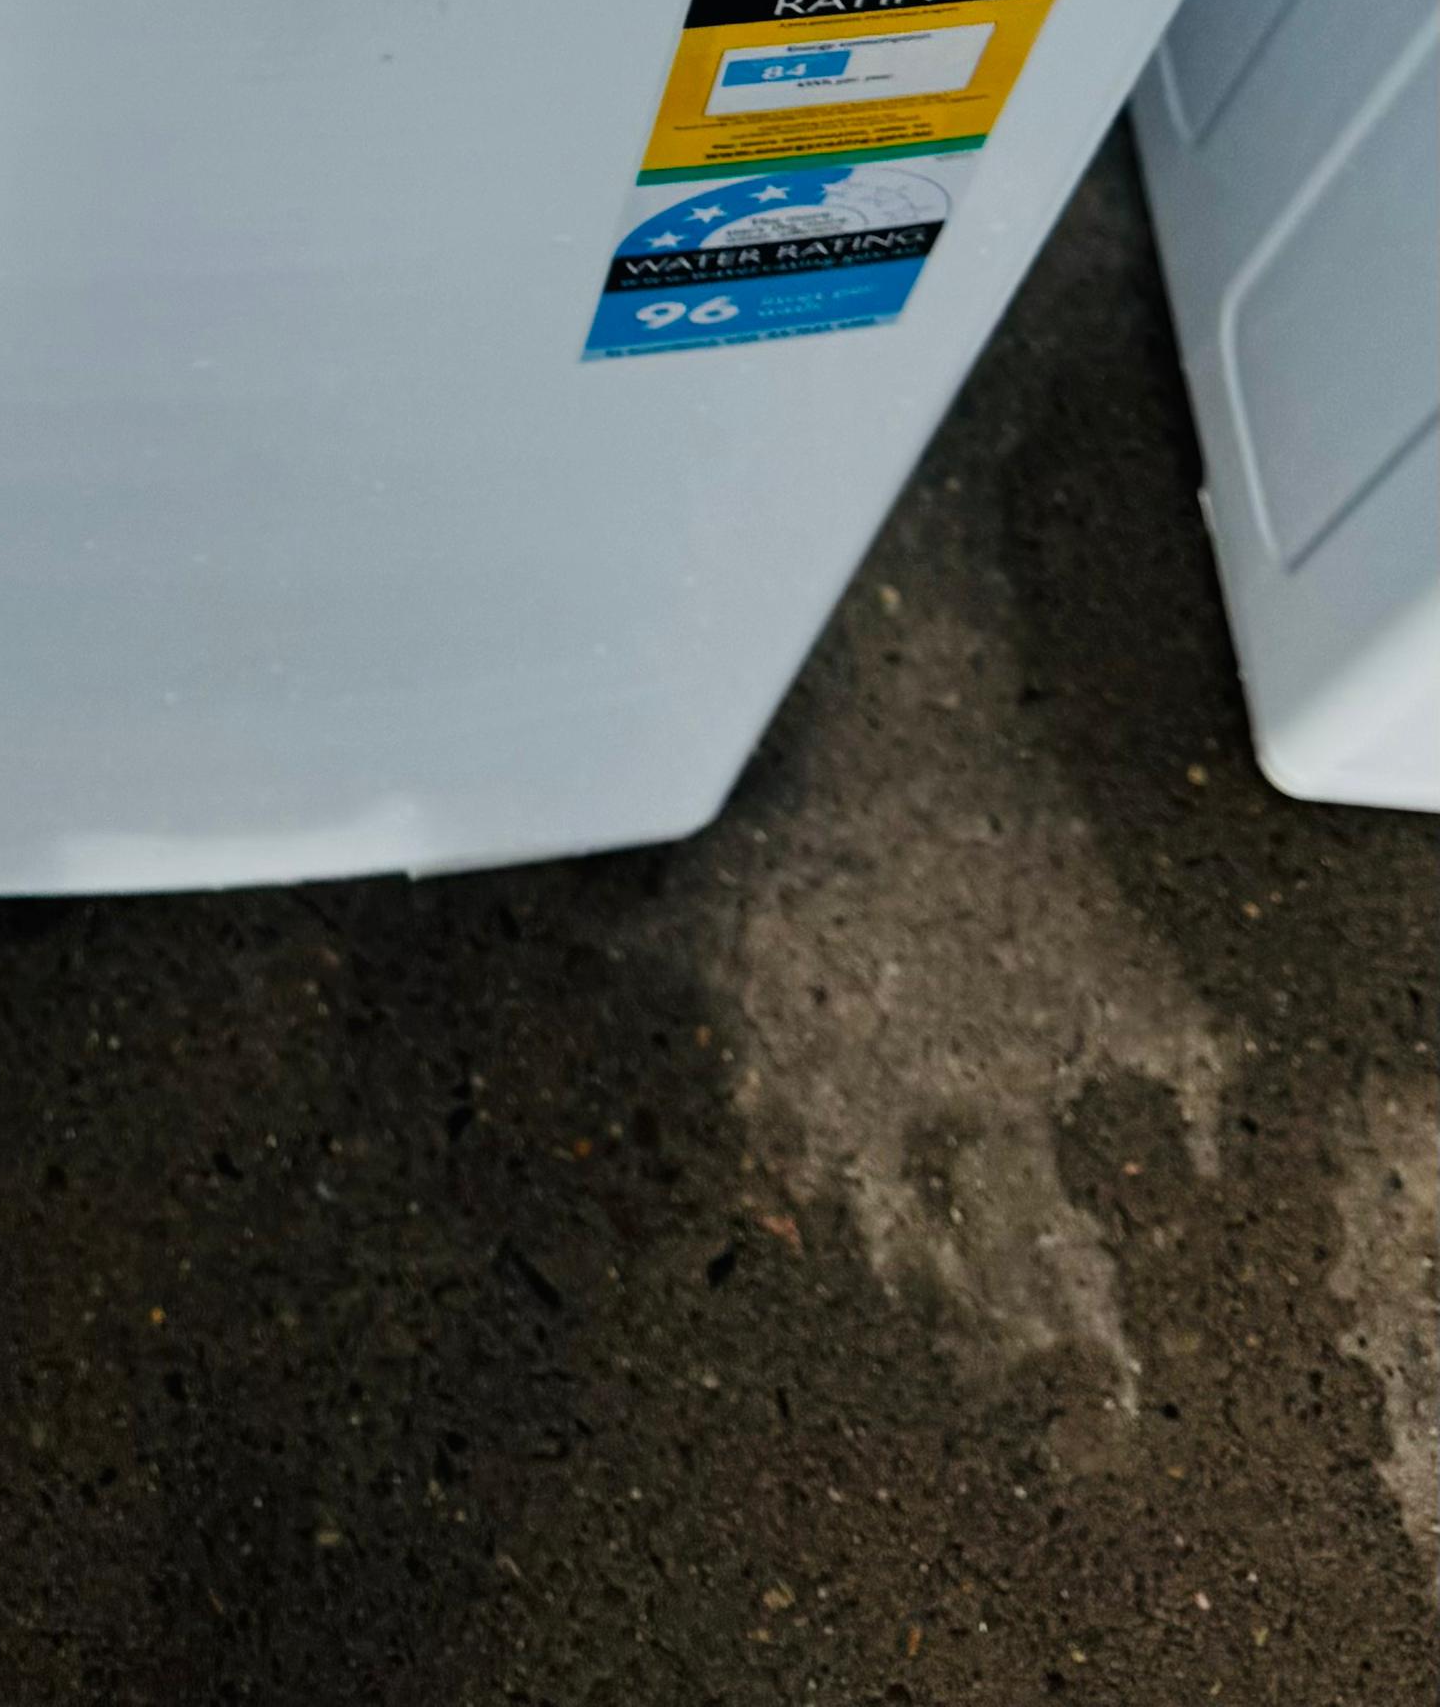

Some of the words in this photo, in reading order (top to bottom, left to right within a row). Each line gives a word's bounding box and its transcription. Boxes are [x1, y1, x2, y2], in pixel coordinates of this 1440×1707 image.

[625, 248, 760, 274] WATER
[777, 228, 928, 259] RATING
[635, 295, 739, 329] 96
